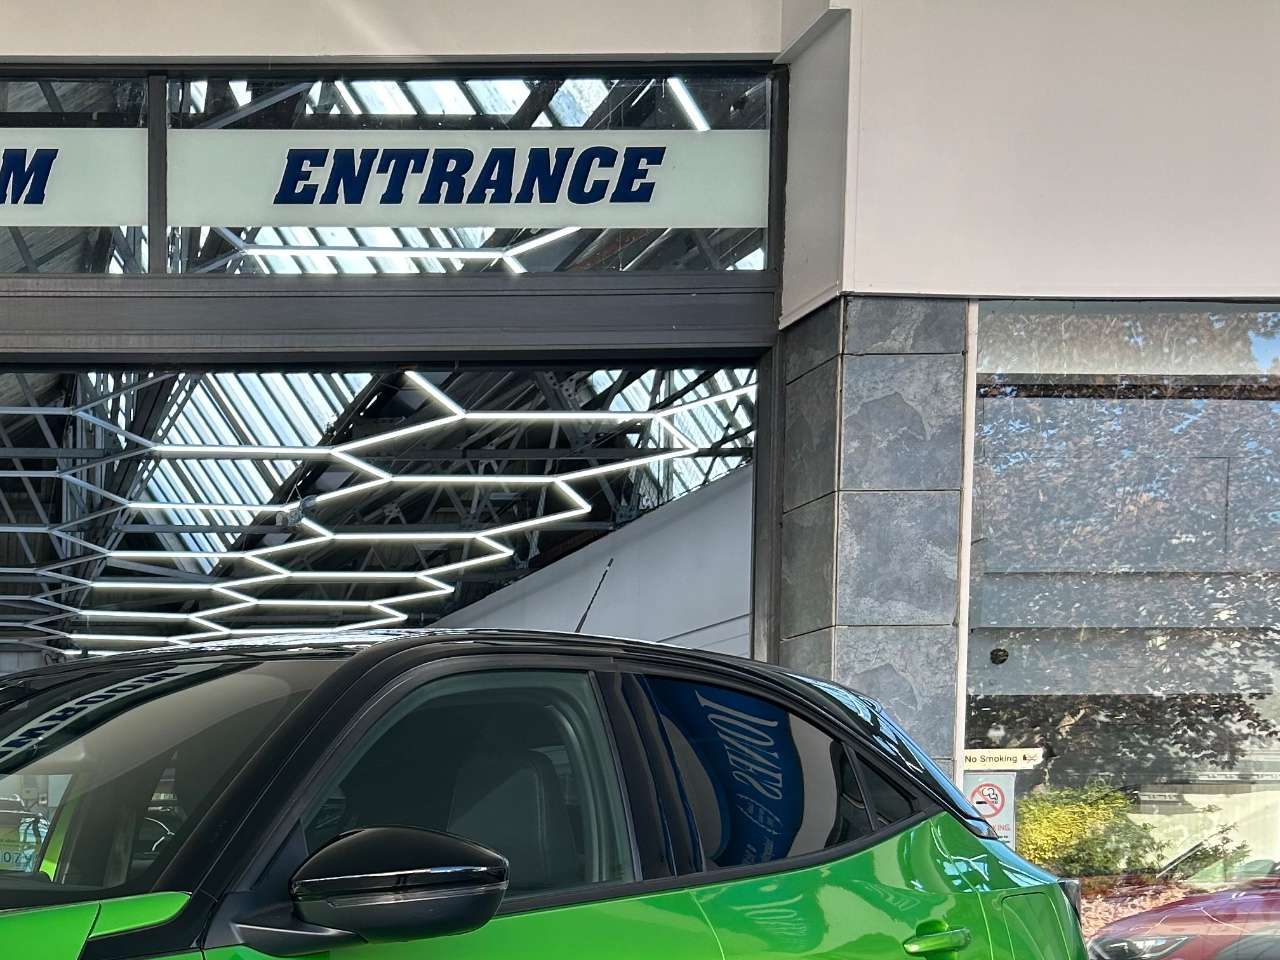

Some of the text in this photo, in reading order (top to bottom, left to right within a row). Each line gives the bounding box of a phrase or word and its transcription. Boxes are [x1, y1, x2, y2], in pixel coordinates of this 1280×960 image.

[273, 145, 667, 206] ENTRANCE
[964, 754, 1018, 764] No Smoking
